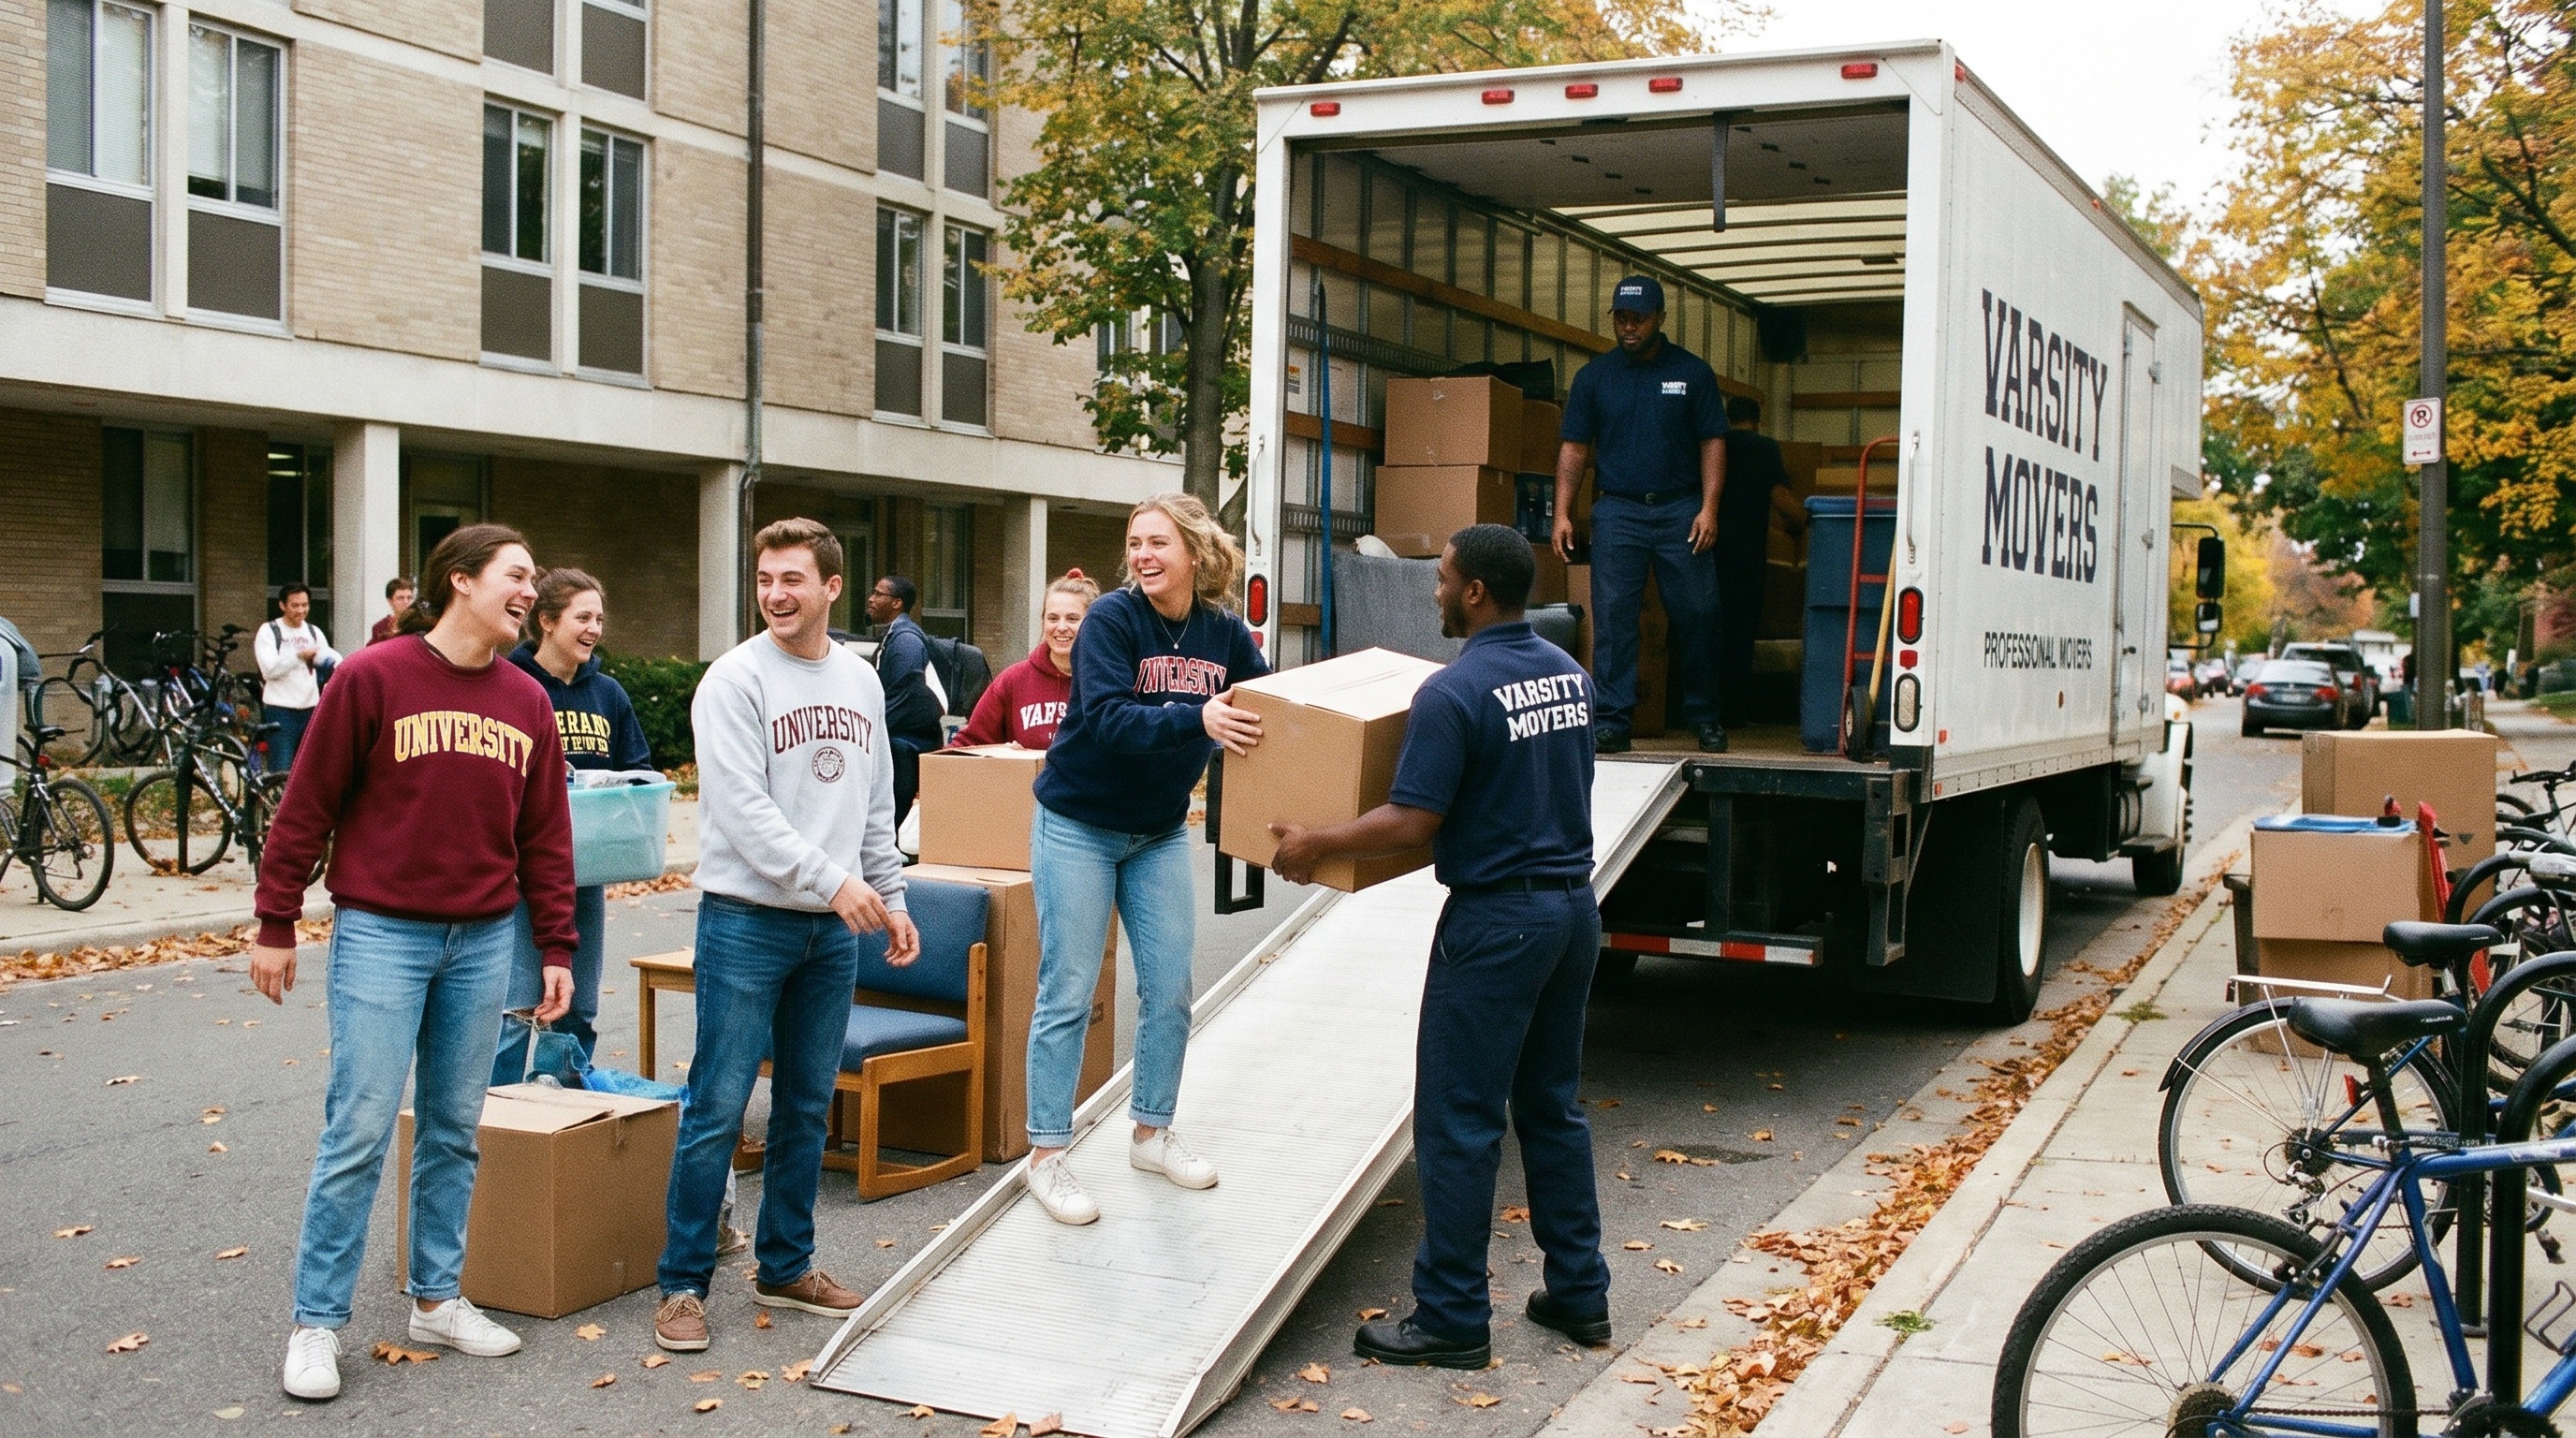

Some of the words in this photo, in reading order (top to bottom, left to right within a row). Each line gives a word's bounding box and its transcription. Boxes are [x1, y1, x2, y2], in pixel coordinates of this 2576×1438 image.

[1982, 287, 2108, 462] VARSITY
[1982, 445, 2098, 584] MOVERS
[1492, 673, 1585, 712] VARSITY
[1506, 701, 1588, 742] MOVERS
[394, 711, 534, 778] UNIVERSITY
[772, 705, 871, 755] UNIVERSITY
